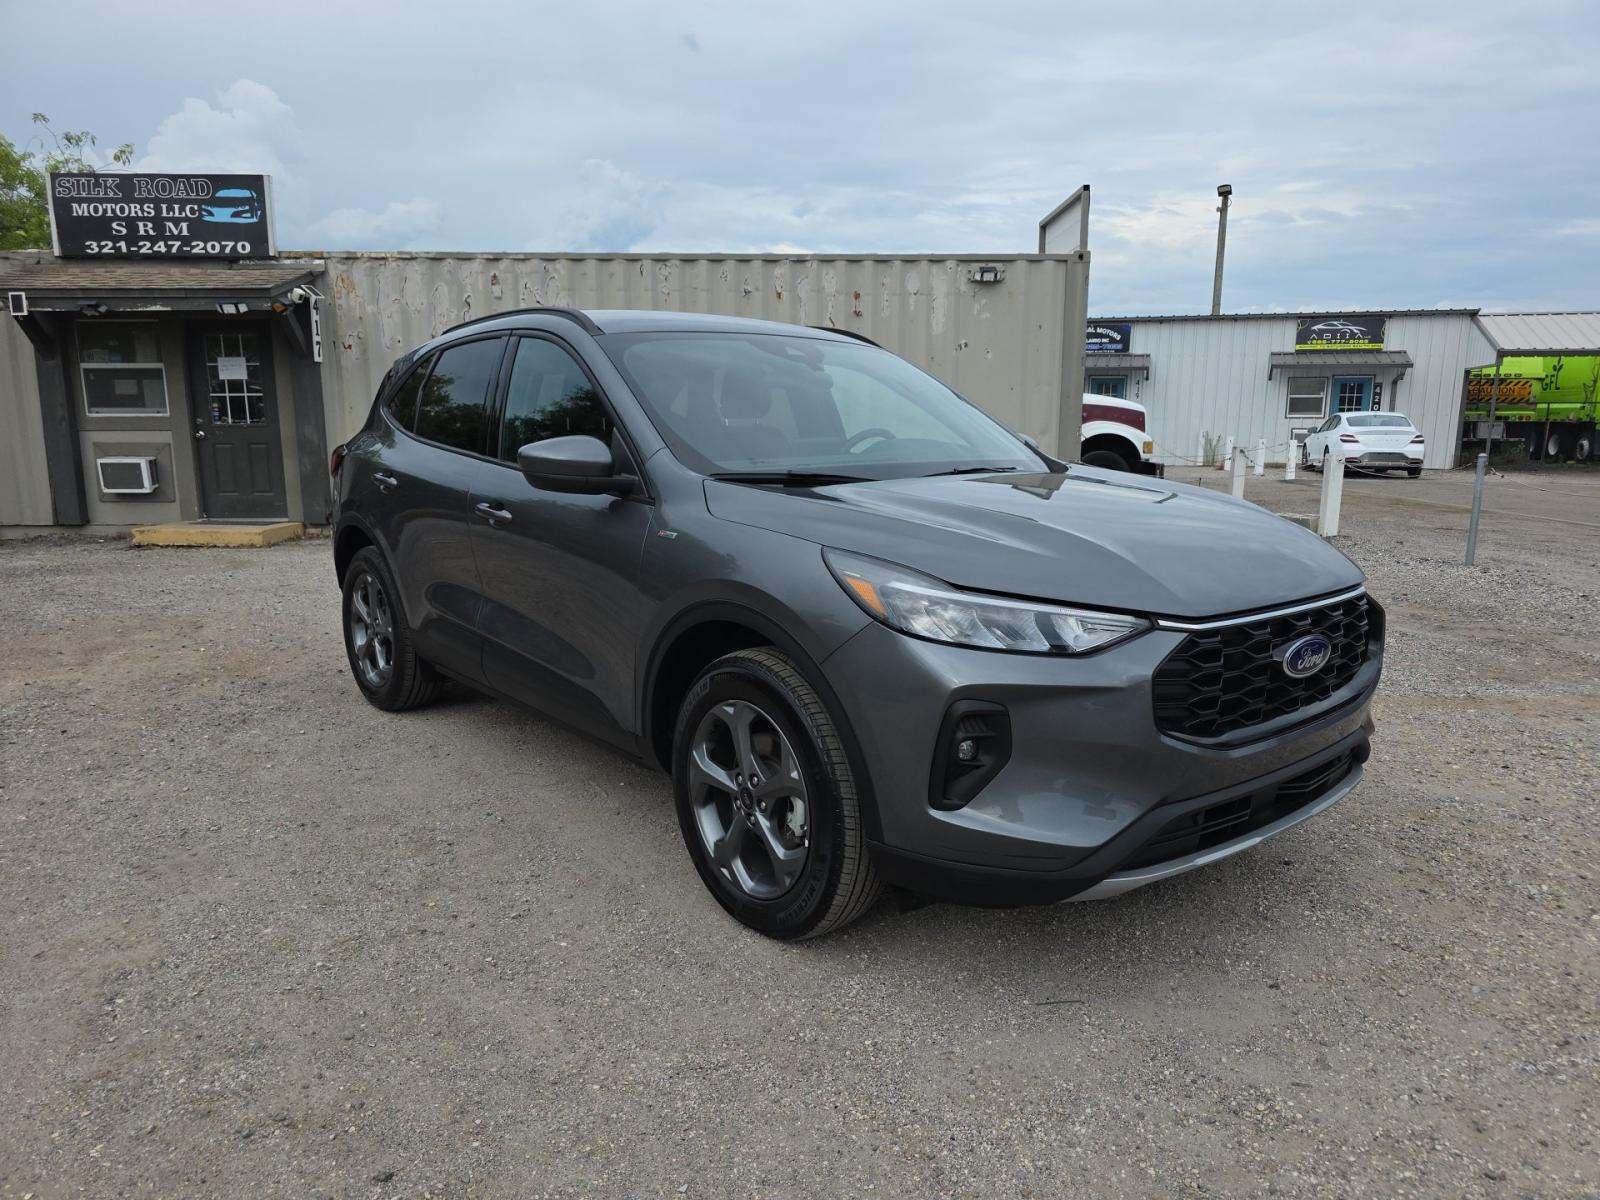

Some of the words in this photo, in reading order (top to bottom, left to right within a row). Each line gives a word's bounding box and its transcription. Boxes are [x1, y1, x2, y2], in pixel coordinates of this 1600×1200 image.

[56, 177, 122, 198] SILK
[134, 178, 212, 199] ROAD
[72, 203, 155, 218] MOTORS
[160, 203, 199, 219] LLC
[84, 240, 251, 254] 321-247-2070
[313, 298, 321, 358] 417
[1097, 327, 1121, 340] MOTORS
[1541, 373, 1560, 391] GFL
[1298, 647, 1325, 669] Ford
